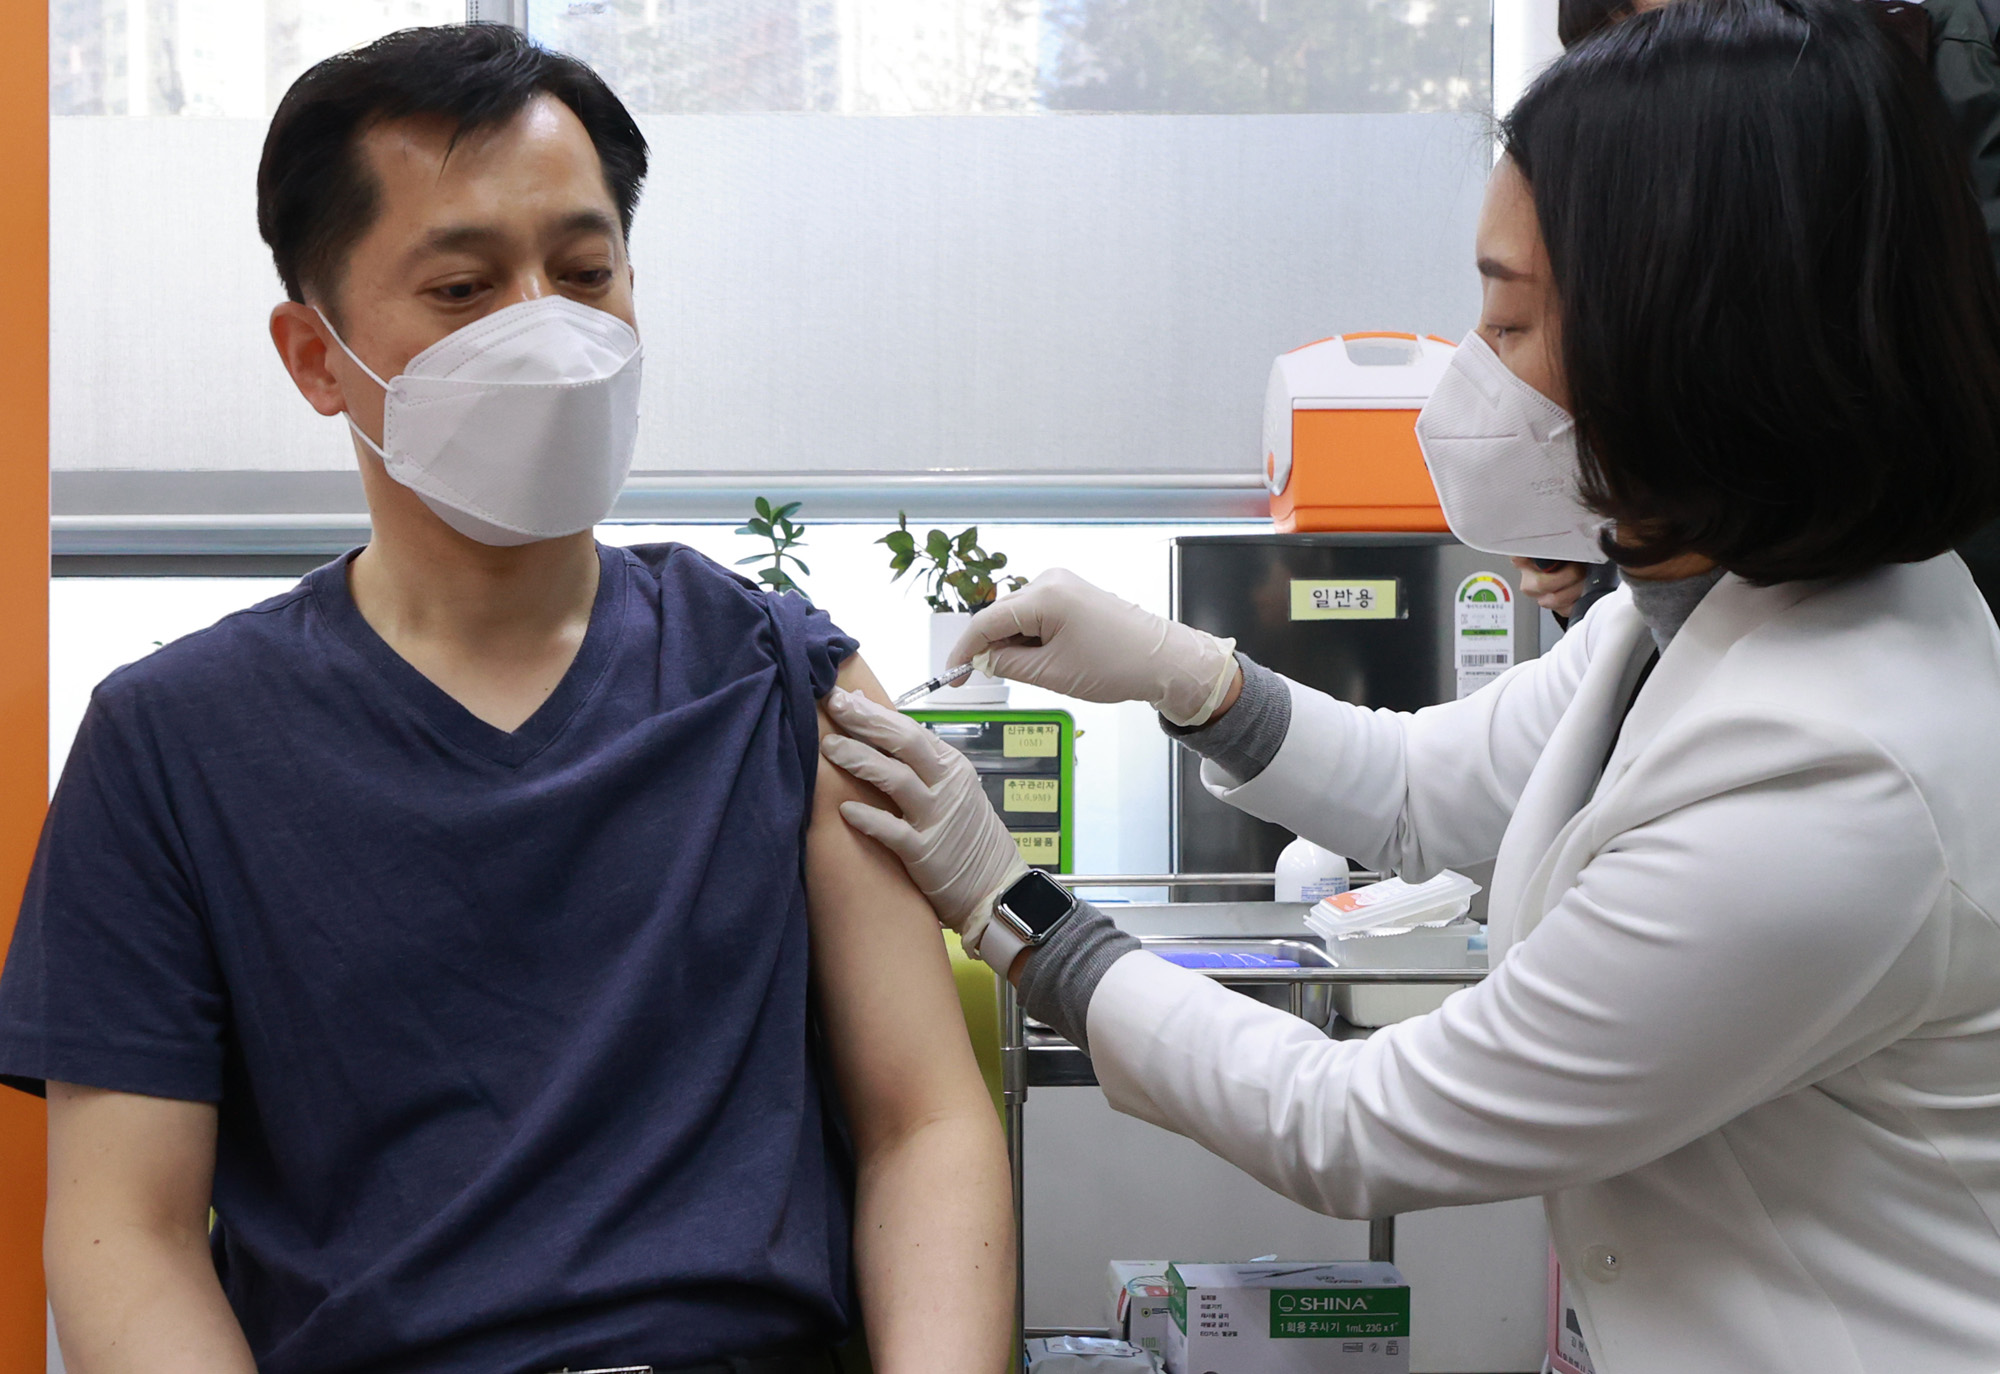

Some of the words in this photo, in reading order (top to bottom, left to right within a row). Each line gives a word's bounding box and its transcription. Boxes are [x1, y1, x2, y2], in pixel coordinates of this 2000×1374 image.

[1312, 588, 1373, 609] 일반용
[1007, 726, 1054, 736] 신규등록자
[1019, 738, 1043, 748] (0M)
[1008, 781, 1055, 790] 추구관리자
[1299, 1297, 1368, 1311] SHINA
[1309, 1321, 1340, 1333] 주사기
[1346, 1323, 1363, 1333] 1mL
[1365, 1323, 1382, 1332] 23G
